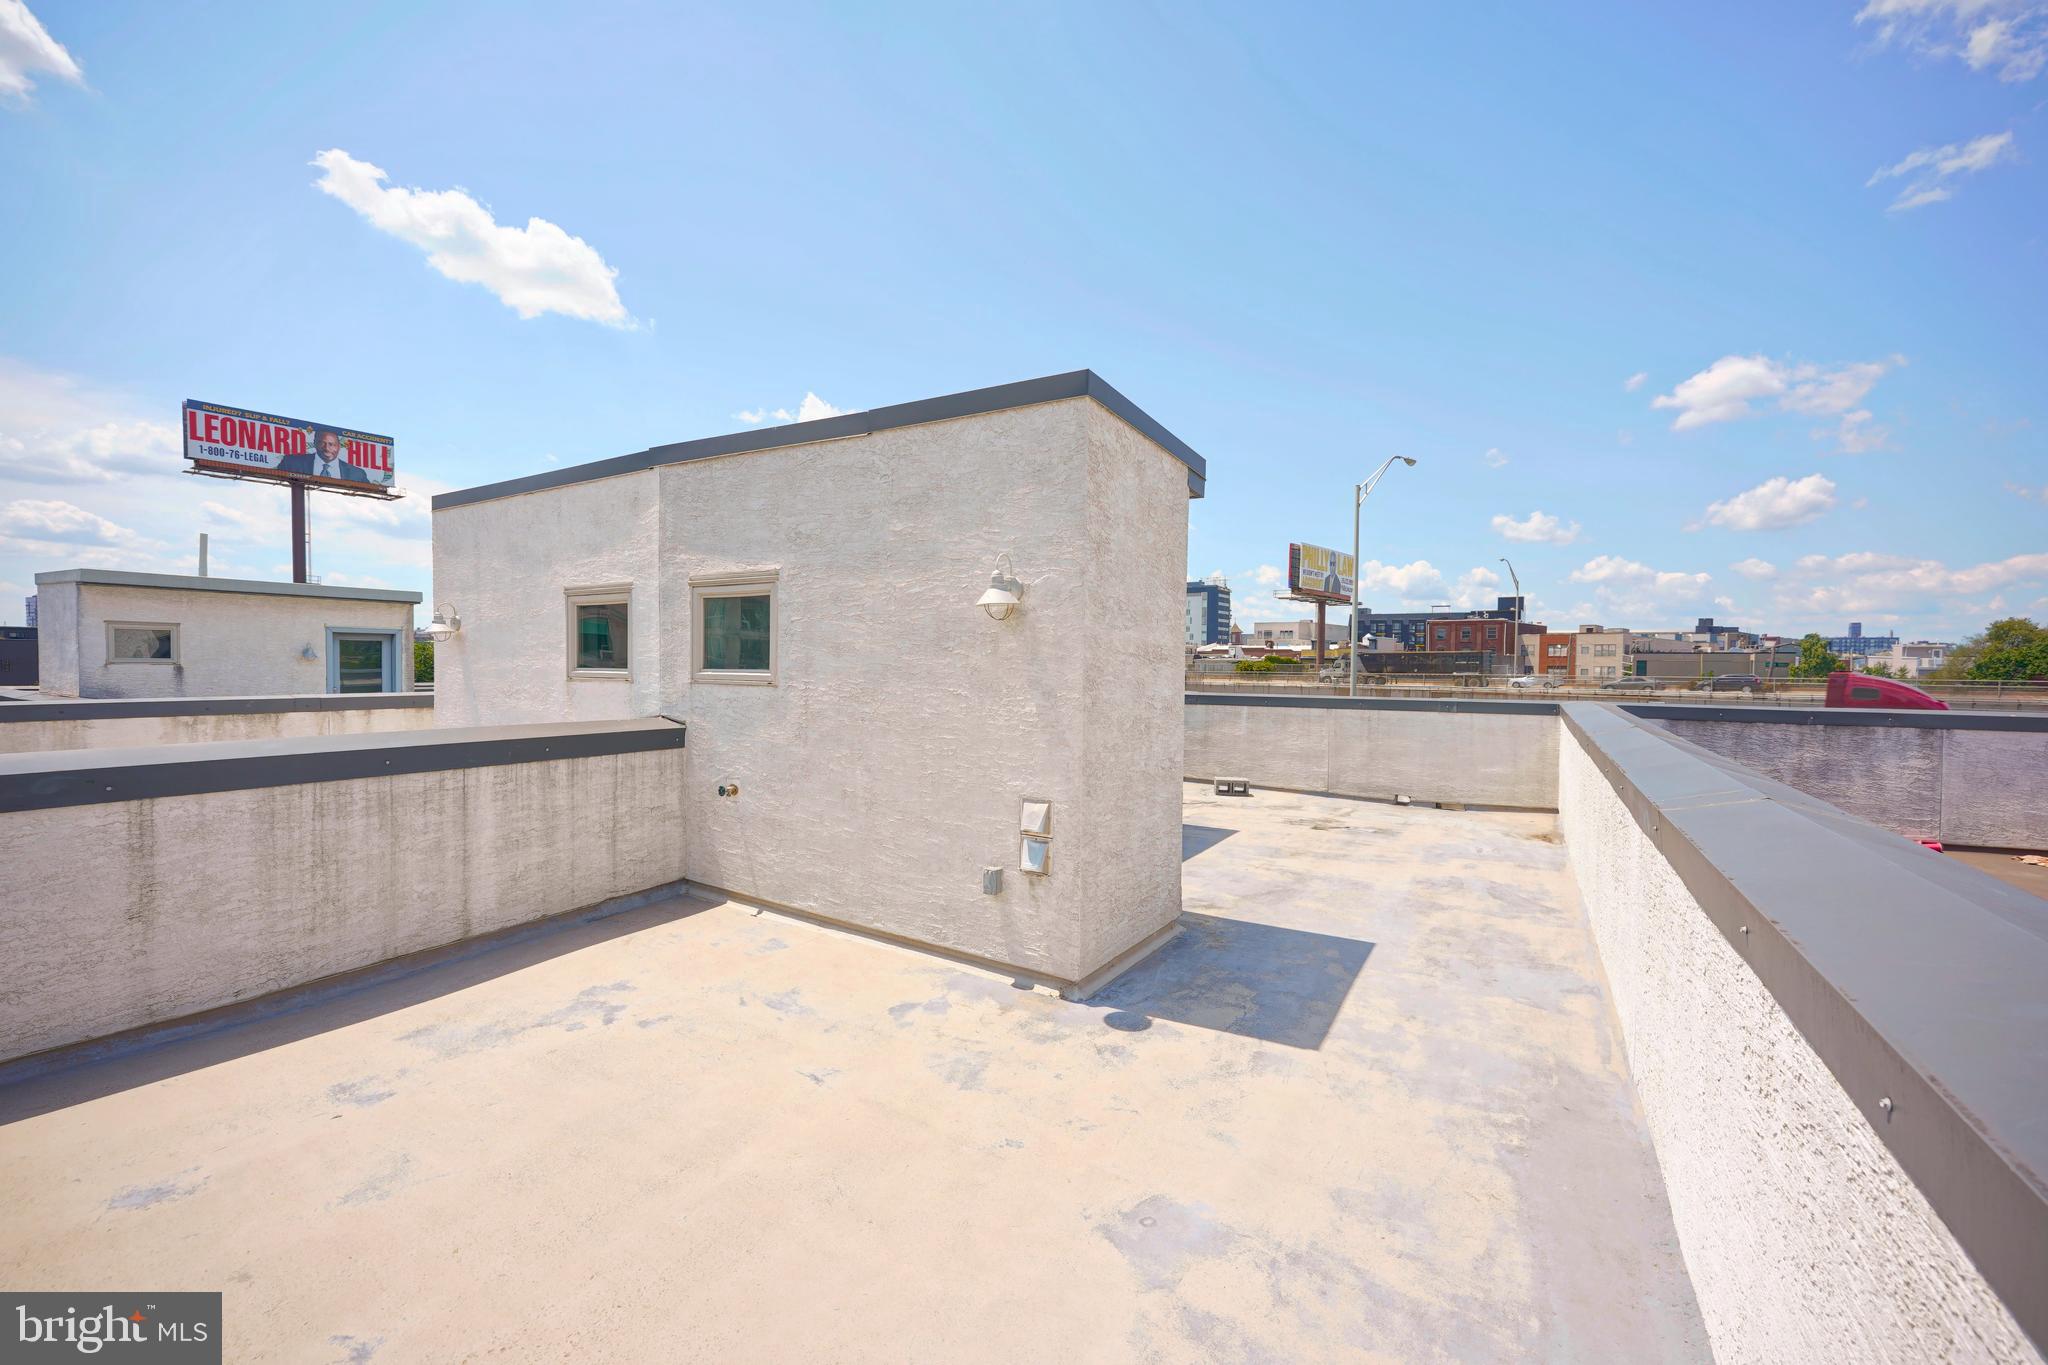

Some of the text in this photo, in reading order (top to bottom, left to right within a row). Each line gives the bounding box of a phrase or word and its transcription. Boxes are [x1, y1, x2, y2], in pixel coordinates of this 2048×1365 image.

[202, 404, 241, 416] INJURED?
[189, 410, 393, 472] LEONARD HILL
[199, 444, 269, 464] 1-800-76-LEGAL
